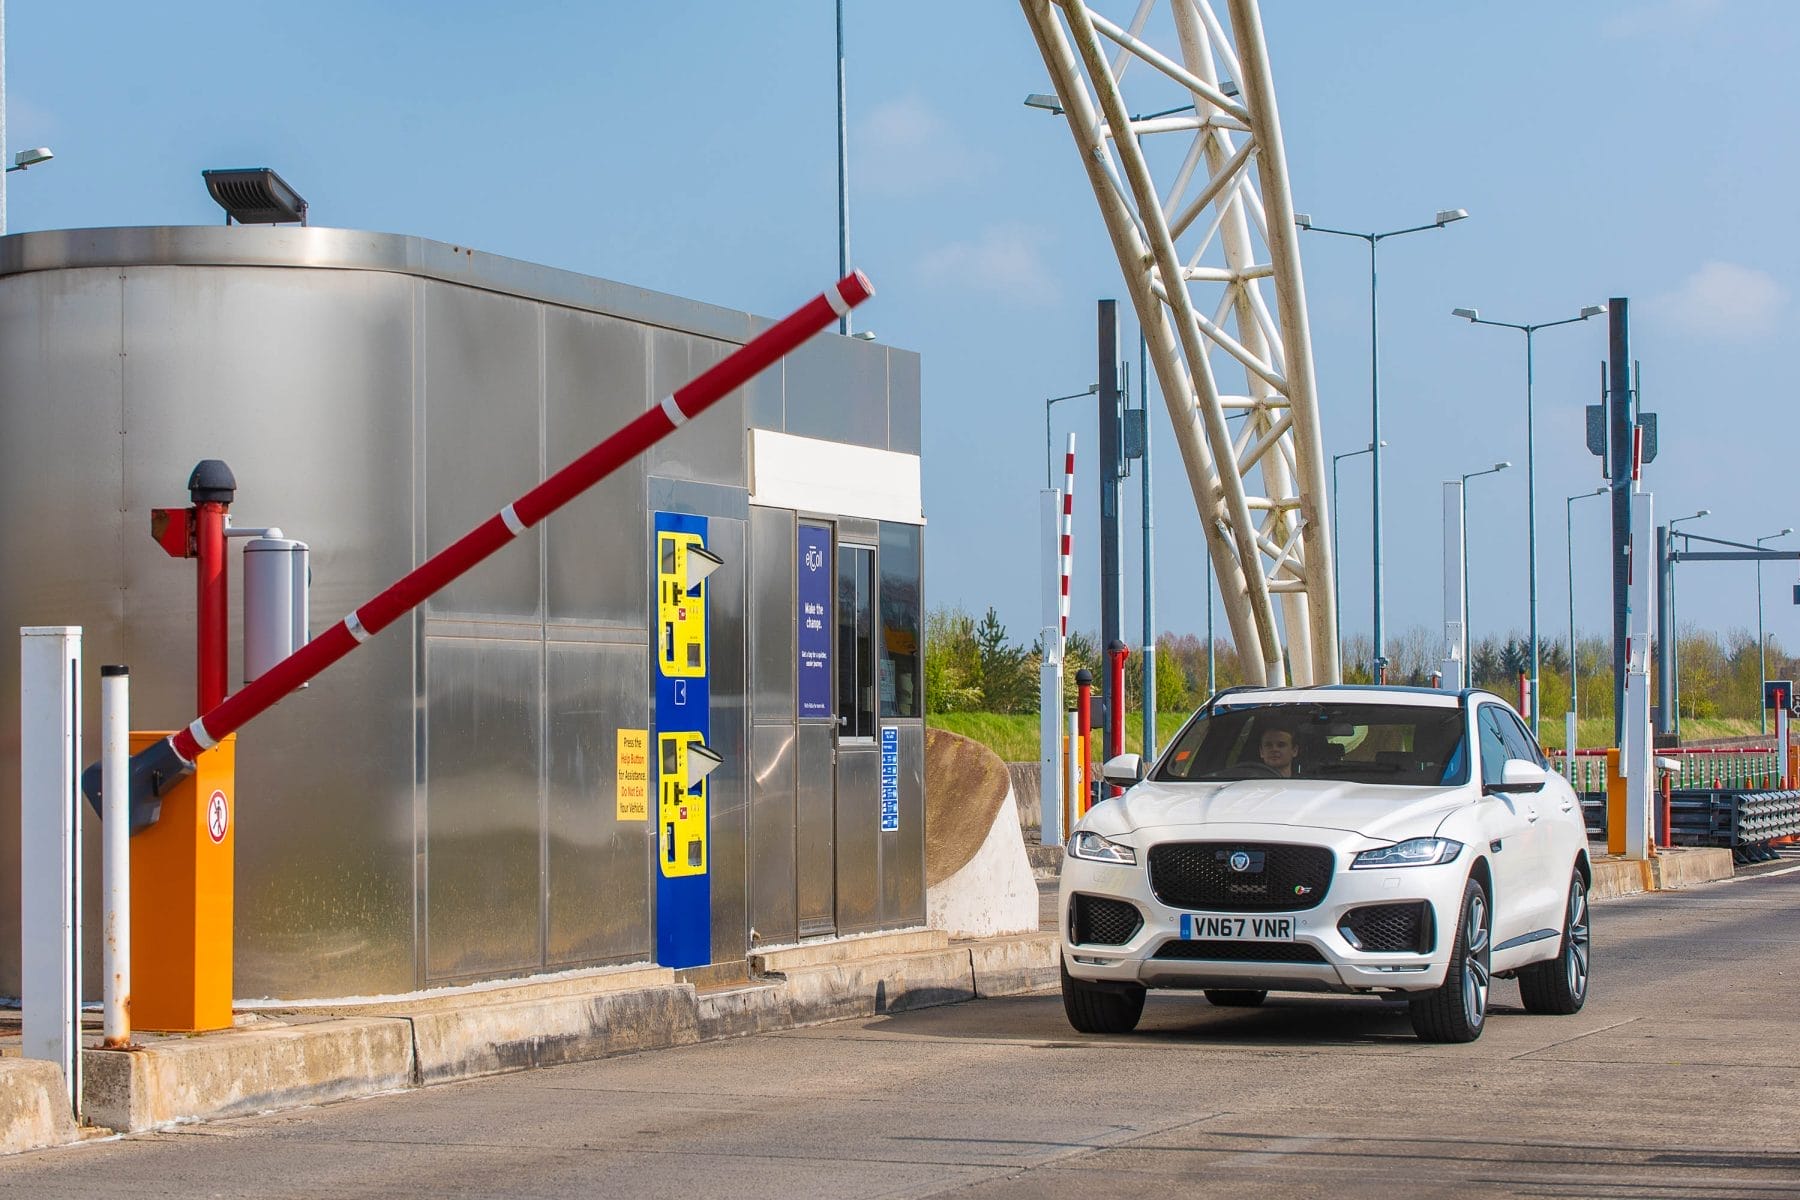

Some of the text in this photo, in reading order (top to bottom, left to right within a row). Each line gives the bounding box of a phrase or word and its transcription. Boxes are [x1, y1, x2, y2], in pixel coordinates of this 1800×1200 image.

[624, 737, 634, 748] Press
[621, 753, 644, 766] Help Button
[622, 786, 627, 797] Do
[636, 786, 644, 797] Exit
[620, 803, 628, 813] Your
[1195, 918, 1290, 938] VN67 VNR
